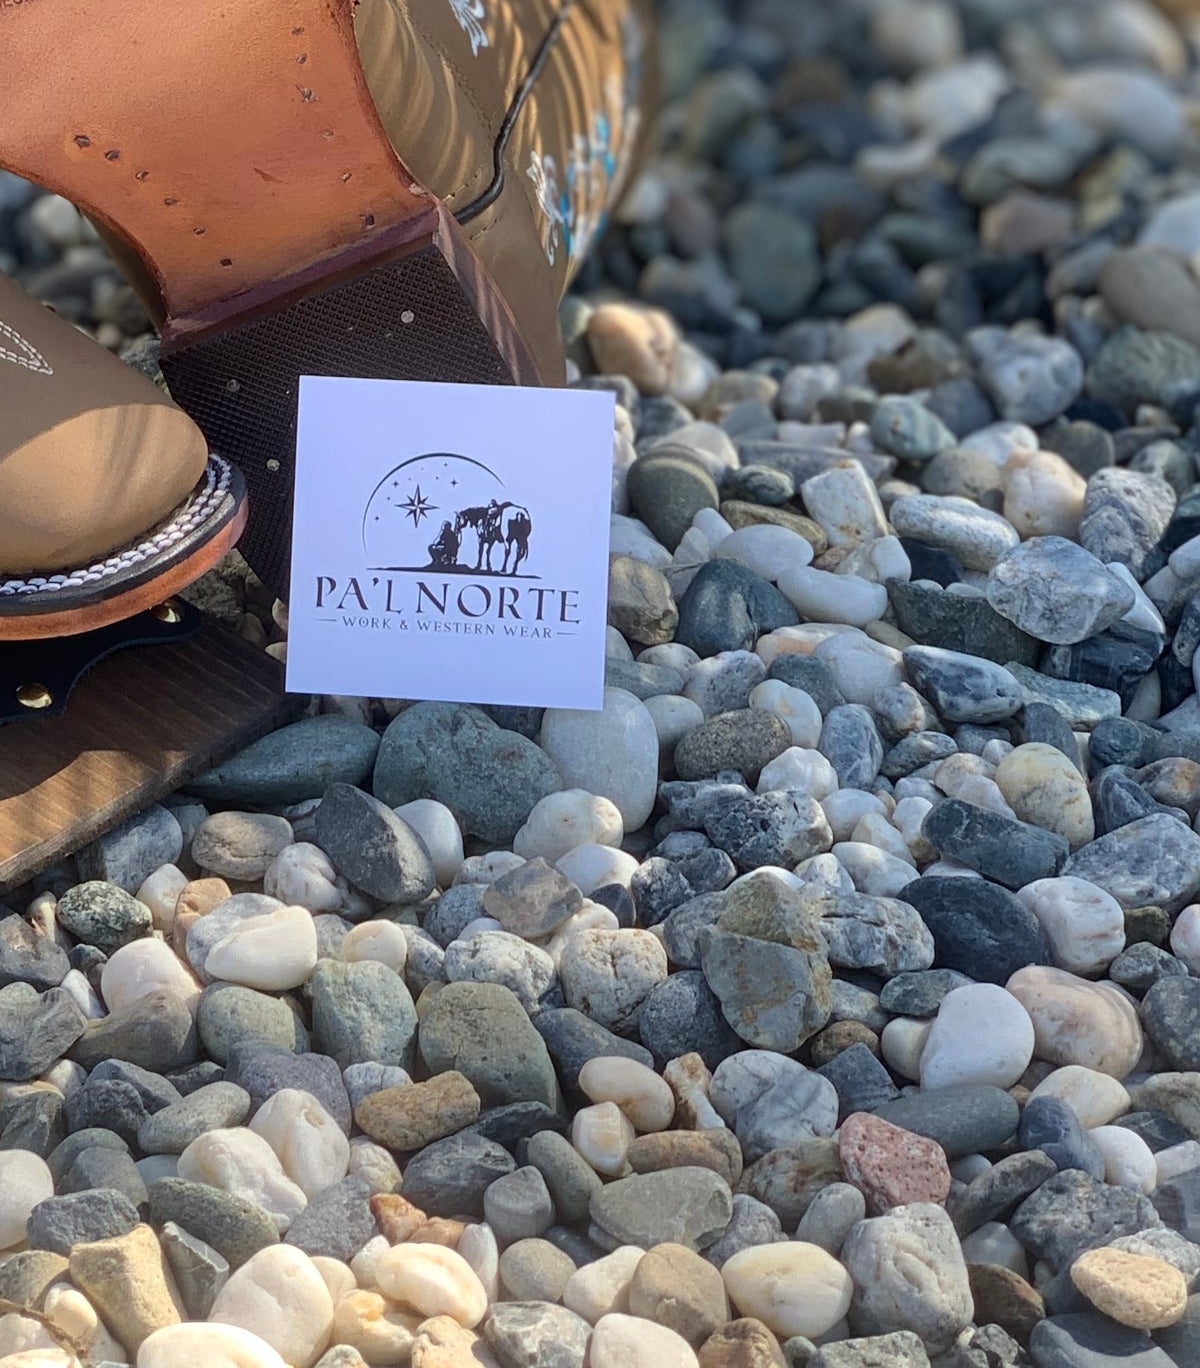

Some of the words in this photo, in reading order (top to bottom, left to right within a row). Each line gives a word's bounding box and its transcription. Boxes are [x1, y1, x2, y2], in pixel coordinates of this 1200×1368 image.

[415, 581, 582, 625] NORTE
[341, 615, 392, 630] WORK
[400, 619, 410, 631] &
[417, 620, 495, 636] WESTERN
[503, 624, 553, 639] WEAR
